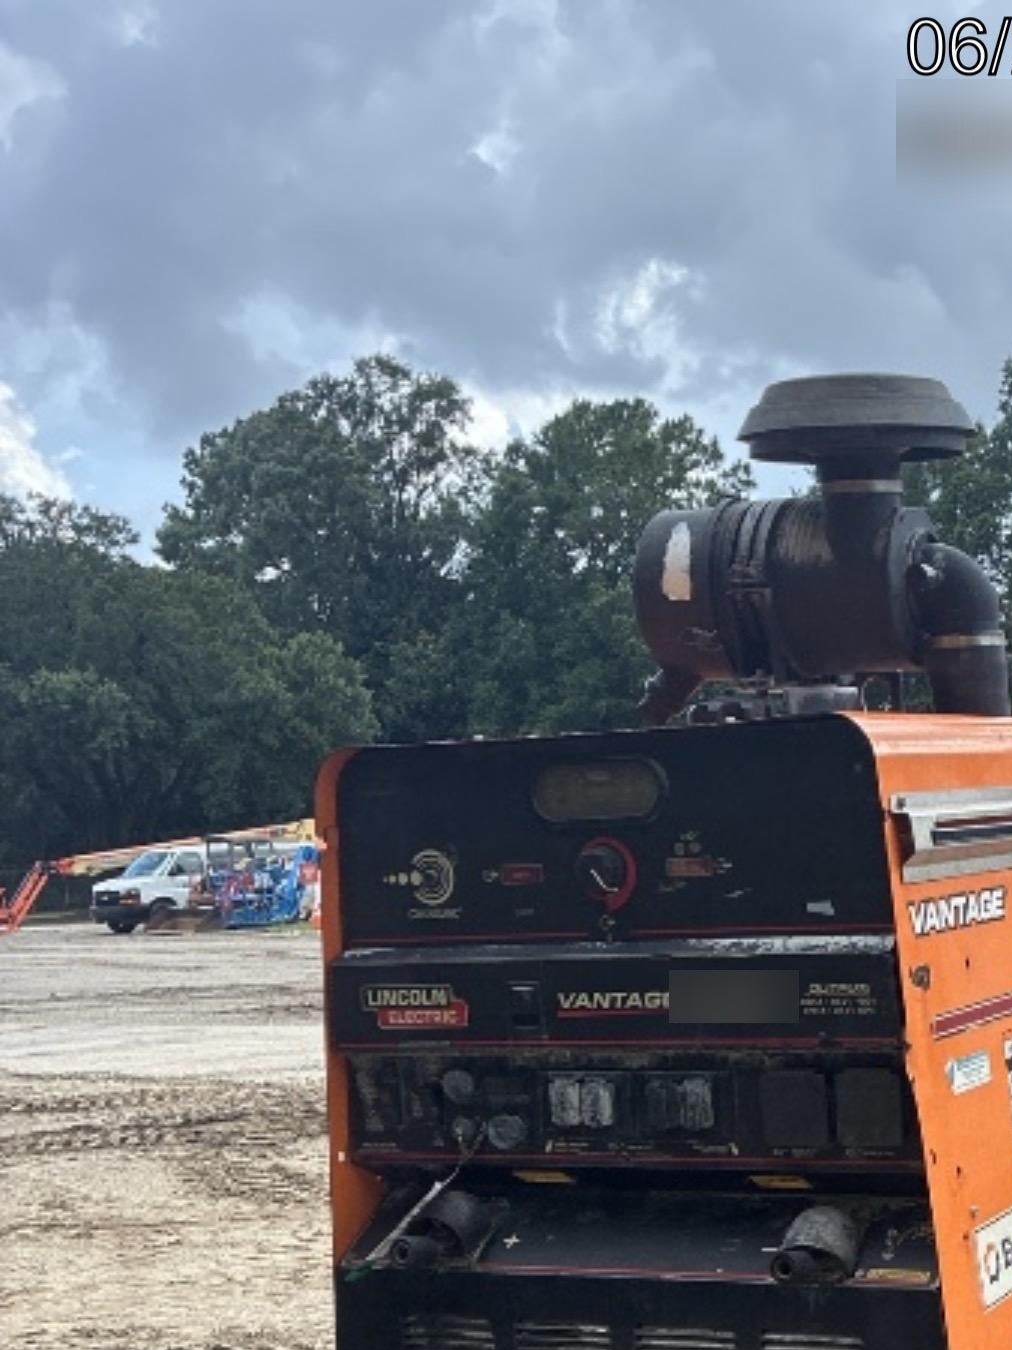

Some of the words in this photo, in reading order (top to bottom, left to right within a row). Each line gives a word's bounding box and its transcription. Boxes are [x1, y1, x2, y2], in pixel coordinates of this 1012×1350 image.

[908, 887, 1006, 936] VANTAGE
[367, 989, 449, 1006] LINCOLN
[388, 1010, 457, 1025] ELECTRIC
